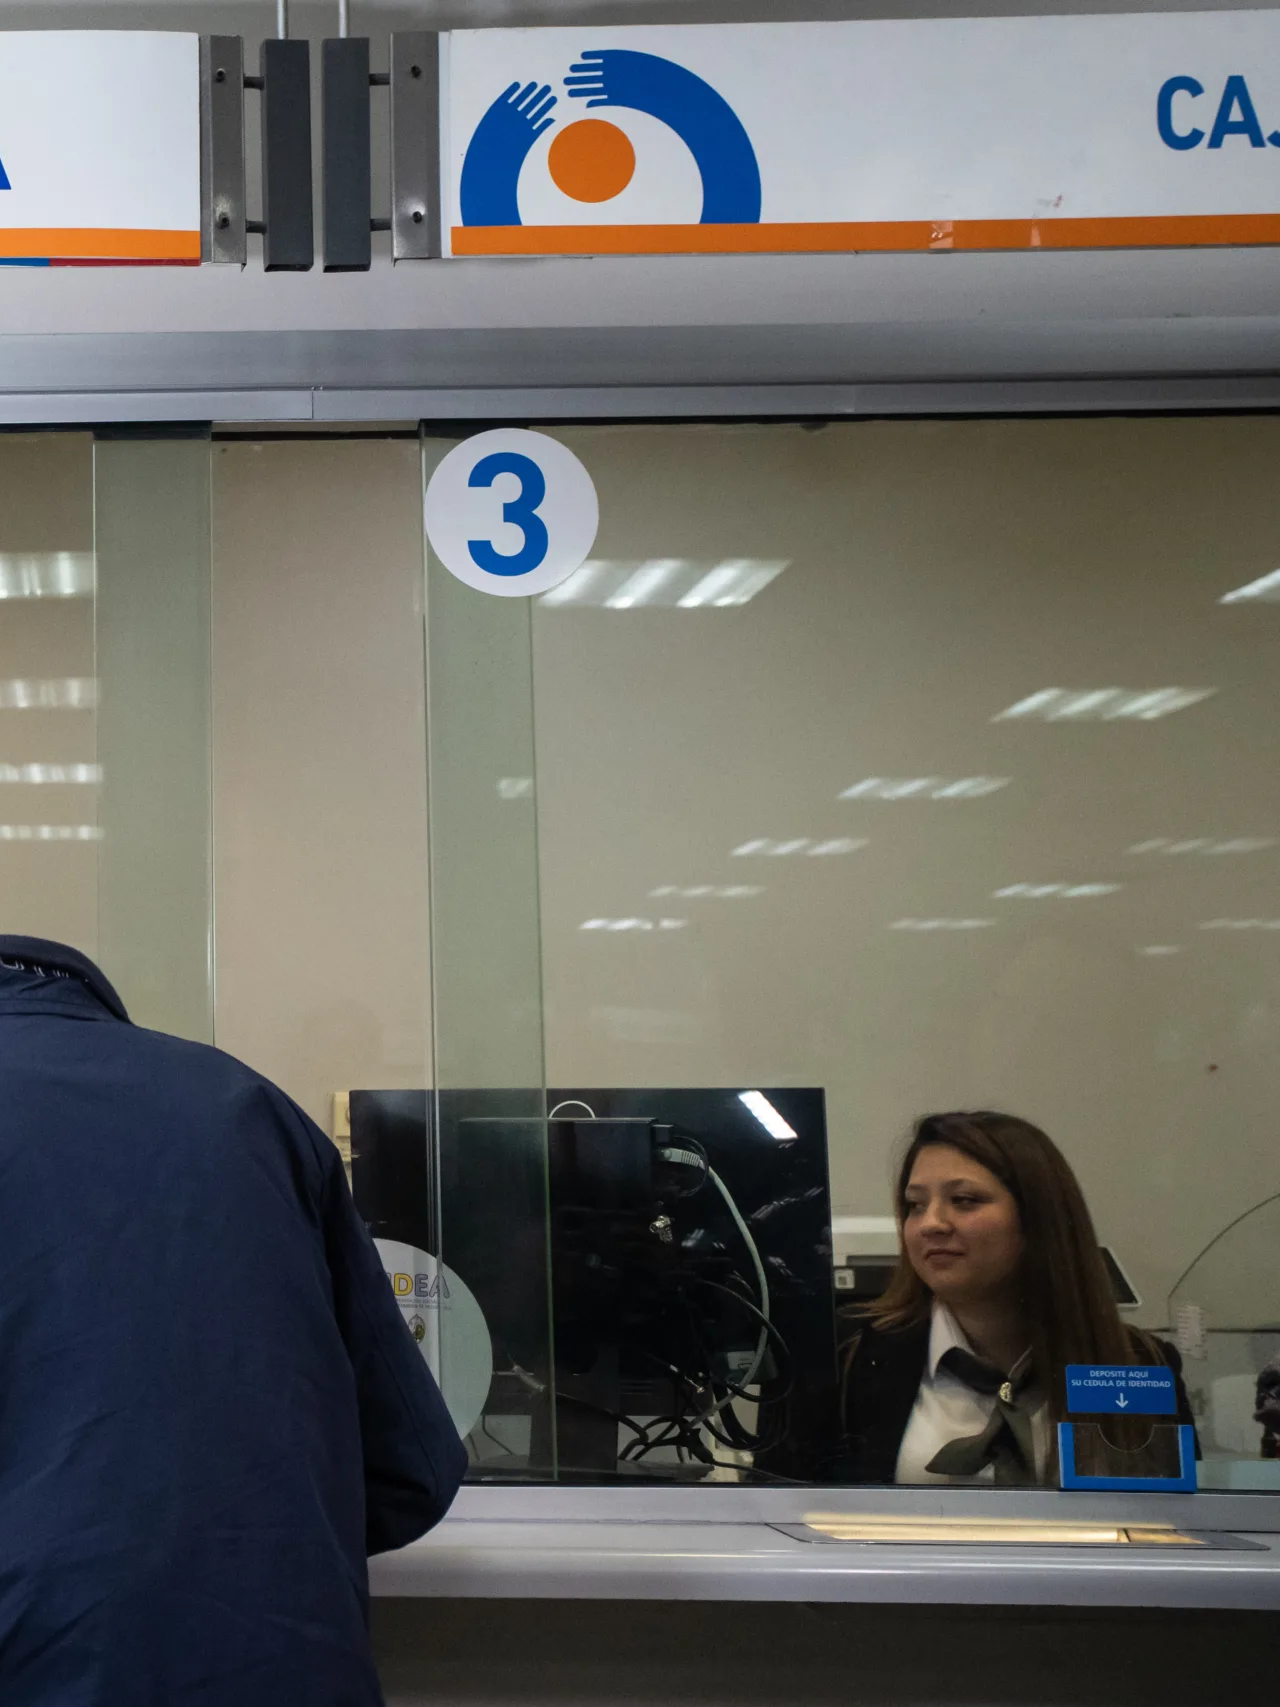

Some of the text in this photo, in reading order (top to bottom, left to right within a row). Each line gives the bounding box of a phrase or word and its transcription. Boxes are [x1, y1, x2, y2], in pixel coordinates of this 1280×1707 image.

[467, 452, 549, 577] 3
[387, 1272, 451, 1299] DEA
[1089, 1370, 1126, 1378] DEPOSITE
[1071, 1379, 1082, 1387] SU
[1128, 1380, 1171, 1388] IDENTIDAD
